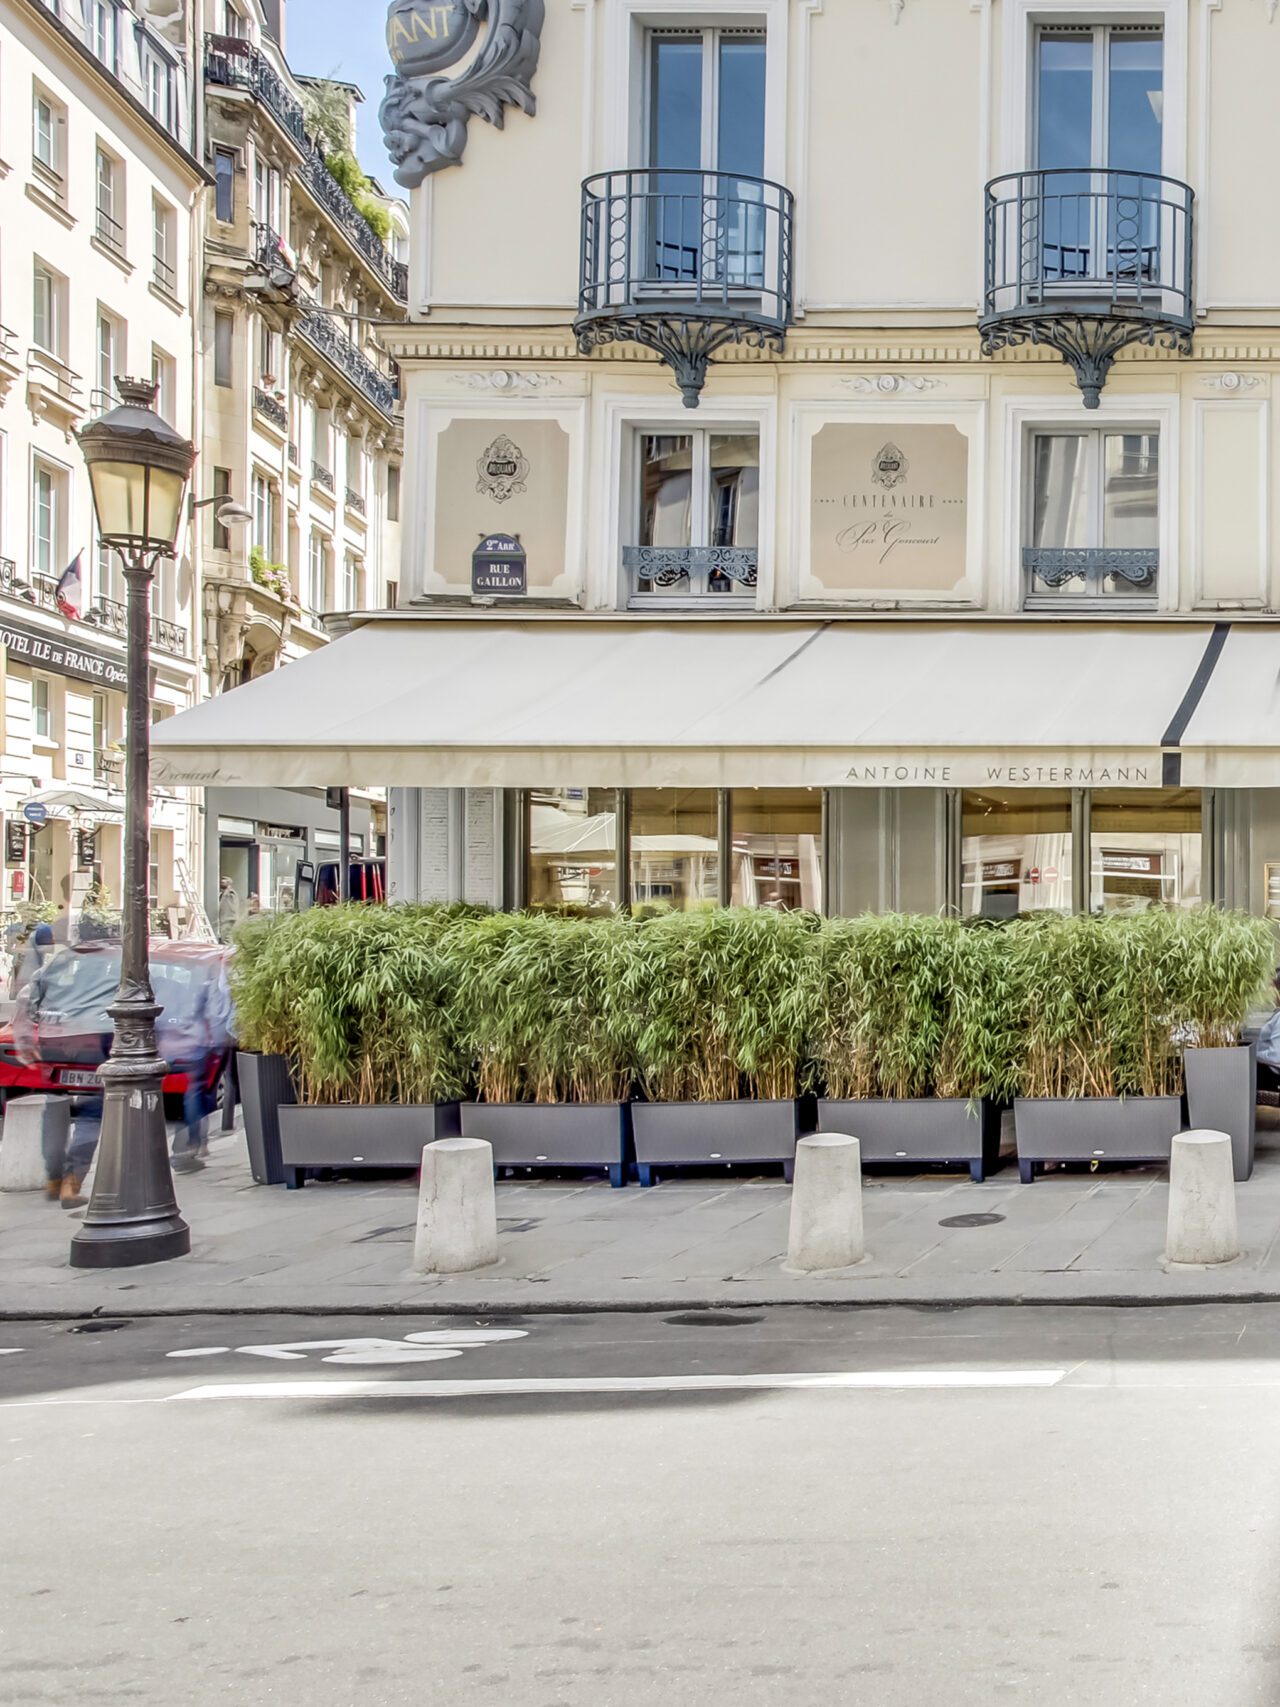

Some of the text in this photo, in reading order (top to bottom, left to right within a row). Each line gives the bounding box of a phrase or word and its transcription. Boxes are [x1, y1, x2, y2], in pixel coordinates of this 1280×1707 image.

[843, 495, 934, 508] CENTENAIRE
[489, 564, 510, 574] RUE
[477, 576, 522, 587] GAILLON
[31, 641, 52, 660] ILE
[52, 651, 63, 664] DE
[64, 650, 105, 676] FRANCE
[846, 766, 1148, 782] ANTOINE WESTERMANN
